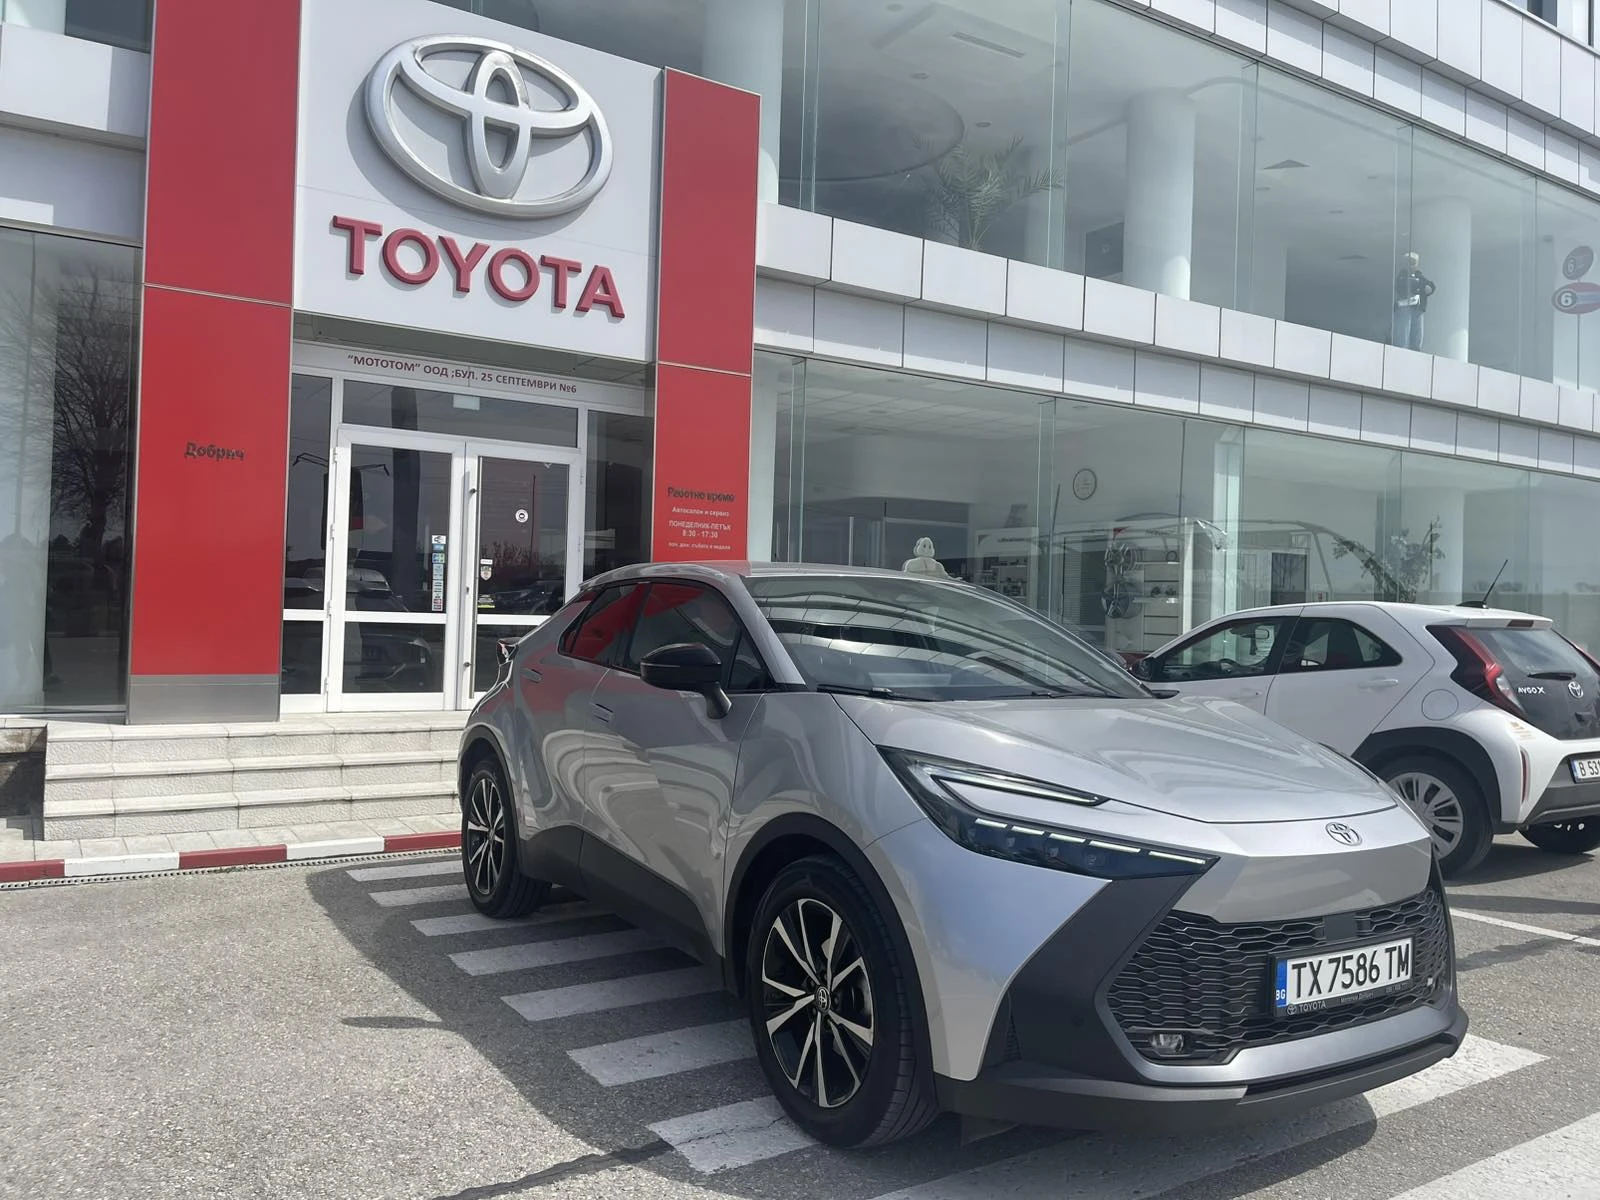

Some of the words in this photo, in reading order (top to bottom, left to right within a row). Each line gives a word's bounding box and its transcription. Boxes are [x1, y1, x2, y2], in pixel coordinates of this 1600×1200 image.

[332, 214, 625, 318] TOYOTA
[1561, 292, 1573, 306] 6
[423, 365, 449, 378] ООД
[481, 372, 493, 382] 25
[495, 374, 557, 391] СЕПТЕМВРИ
[559, 383, 577, 393] №6
[184, 442, 245, 462] Добрич
[667, 487, 705, 499] Работно
[706, 491, 735, 502] време
[672, 506, 704, 515] Автосалон
[709, 510, 729, 518] сервиз
[1579, 762, 1586, 776] B
[1291, 960, 1323, 998] TX
[1328, 951, 1380, 993] 7586
[1385, 944, 1409, 980] TM
[1275, 989, 1287, 1000] BG
[1299, 1000, 1327, 1013] TOYOTA
